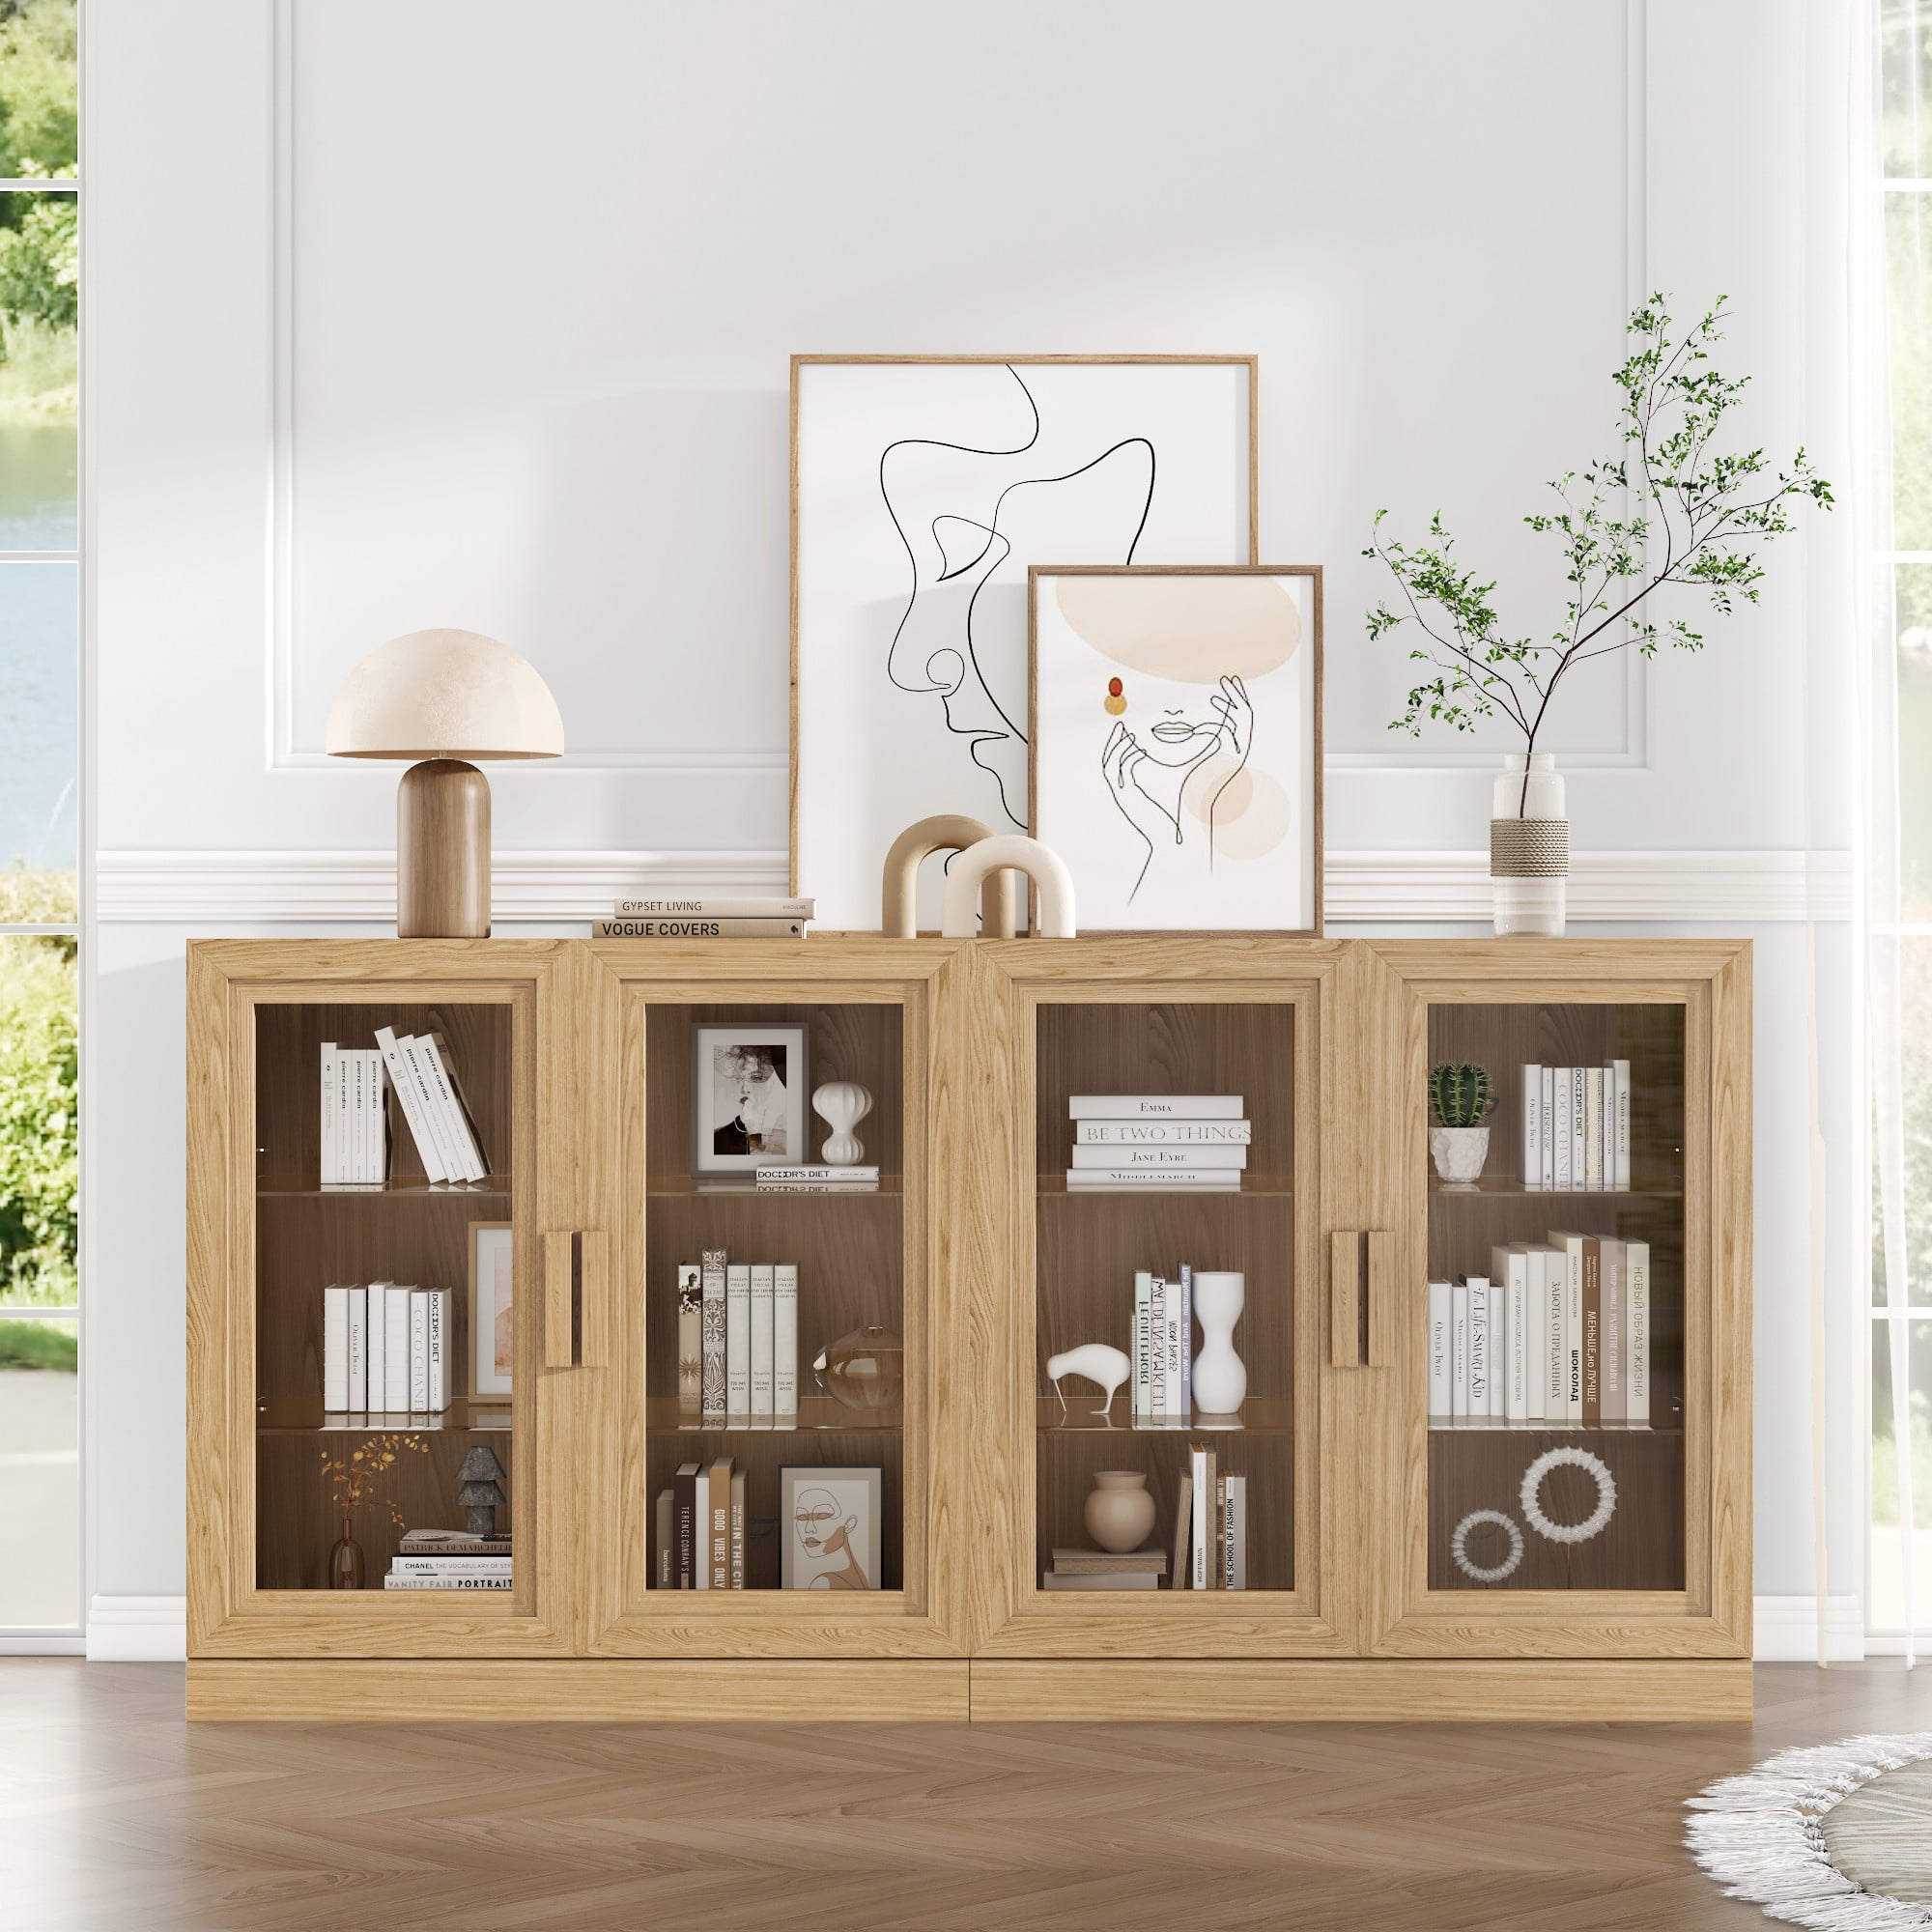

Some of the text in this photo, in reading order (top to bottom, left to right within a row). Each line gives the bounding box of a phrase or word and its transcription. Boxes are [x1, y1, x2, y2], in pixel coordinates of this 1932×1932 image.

[622, 901, 702, 911] GYPSET LIVING
[602, 923, 720, 935] VOGUE COVERS
[406, 1048, 418, 1073] pierre
[417, 1075, 430, 1101] cardin
[425, 1048, 438, 1072] pierre
[436, 1074, 448, 1100] cardin
[1140, 1102, 1172, 1112] EMMA
[1088, 1126, 1252, 1140] BE TWO THINGS
[1131, 1151, 1187, 1162] JANE EYRE
[1551, 1281, 1561, 1320] ЗАБОТА
[1435, 1321, 1444, 1376] OLIVER TWIST
[1634, 1266, 1645, 1397] НОВЫЙ ОБРАЗ ЖИЗНИ
[1551, 1333, 1561, 1399] ПРЕДАННЫХ
[1571, 1350, 1579, 1402] ШОКОЛАД
[1587, 1368, 1596, 1403] ЛУЧШЕ
[715, 1509, 725, 1588] GOOD VIBES ONLY
[733, 1527, 742, 1540] IN
[1227, 1531, 1235, 1540] OF
[733, 1544, 742, 1567] THE
